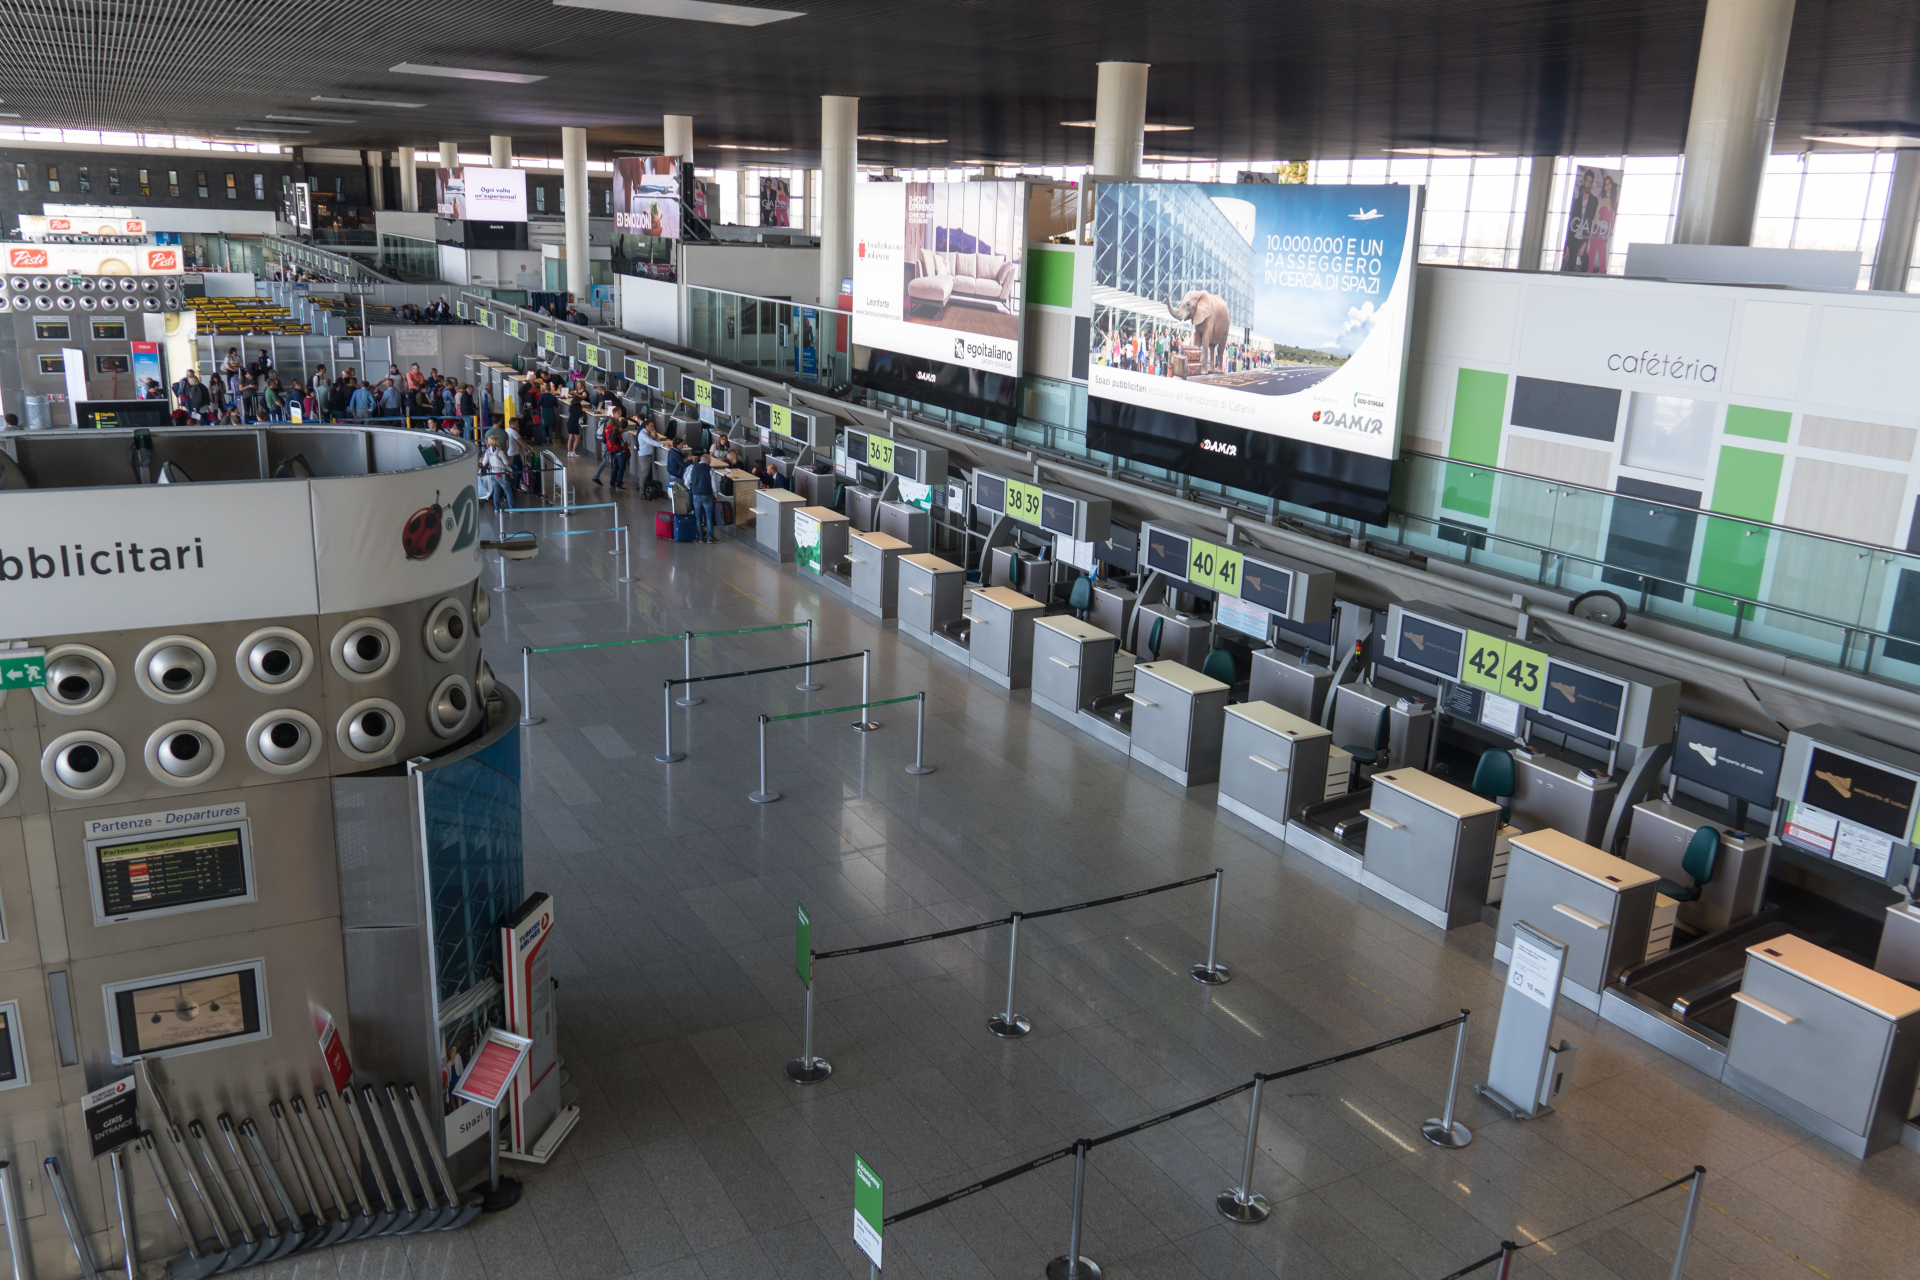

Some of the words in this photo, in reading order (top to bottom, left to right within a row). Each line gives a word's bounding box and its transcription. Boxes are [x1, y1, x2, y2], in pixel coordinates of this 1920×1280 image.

[616, 212, 623, 227] ED
[625, 213, 652, 230] EMOZIONI
[1361, 239, 1383, 256] UN
[12, 250, 47, 266] Pisti
[150, 252, 175, 268] Pisti
[1266, 252, 1381, 276] PASSEGGERO
[1265, 270, 1276, 285] IN
[1279, 270, 1324, 289] CERCA
[1325, 274, 1338, 290] DI
[1341, 275, 1380, 294] SPAZI
[866, 297, 890, 309] Leonforte
[967, 343, 1012, 362] egoitaliano
[1607, 350, 1717, 383] cafétéria
[697, 385, 703, 398] 33
[704, 386, 710, 401] 34
[1095, 376, 1111, 386] Spazi
[1112, 379, 1147, 394] pubblicitari
[1148, 386, 1174, 400] esclusivi
[1228, 401, 1256, 415] Catania
[773, 410, 781, 426] 35
[1322, 410, 1383, 435] DAMIR
[870, 440, 881, 460] 36
[882, 442, 893, 465] 37
[1204, 439, 1237, 456] DAMIR
[1008, 488, 1023, 510] 38
[1025, 491, 1040, 514] 39
[1193, 552, 1213, 576] 40
[1219, 561, 1236, 585] 41
[1468, 646, 1501, 680] 42
[1506, 661, 1540, 692] 43
[1717, 755, 1740, 766] aeroporto
[1745, 765, 1764, 775] catania
[92, 818, 152, 833] Partenze
[166, 806, 240, 824] Departures
[103, 847, 139, 856] Partenze
[145, 840, 185, 851] Departures
[519, 920, 541, 944] TURKISH
[520, 928, 541, 952] AIRLINES
[1527, 982, 1533, 991] 15
[1534, 987, 1546, 998] min.
[91, 1086, 115, 1100] TURKISH
[92, 1091, 115, 1104] AIRLINES
[94, 1118, 134, 1141] ENTRANCE
[459, 1111, 484, 1134] Spazi
[1139, 1120, 1158, 1129] Lufthansa
[1033, 1156, 1053, 1166] Lufthansa
[857, 1159, 880, 1190] Economy
[857, 1168, 871, 1188] Class
[949, 1189, 969, 1200] Lufthansa
